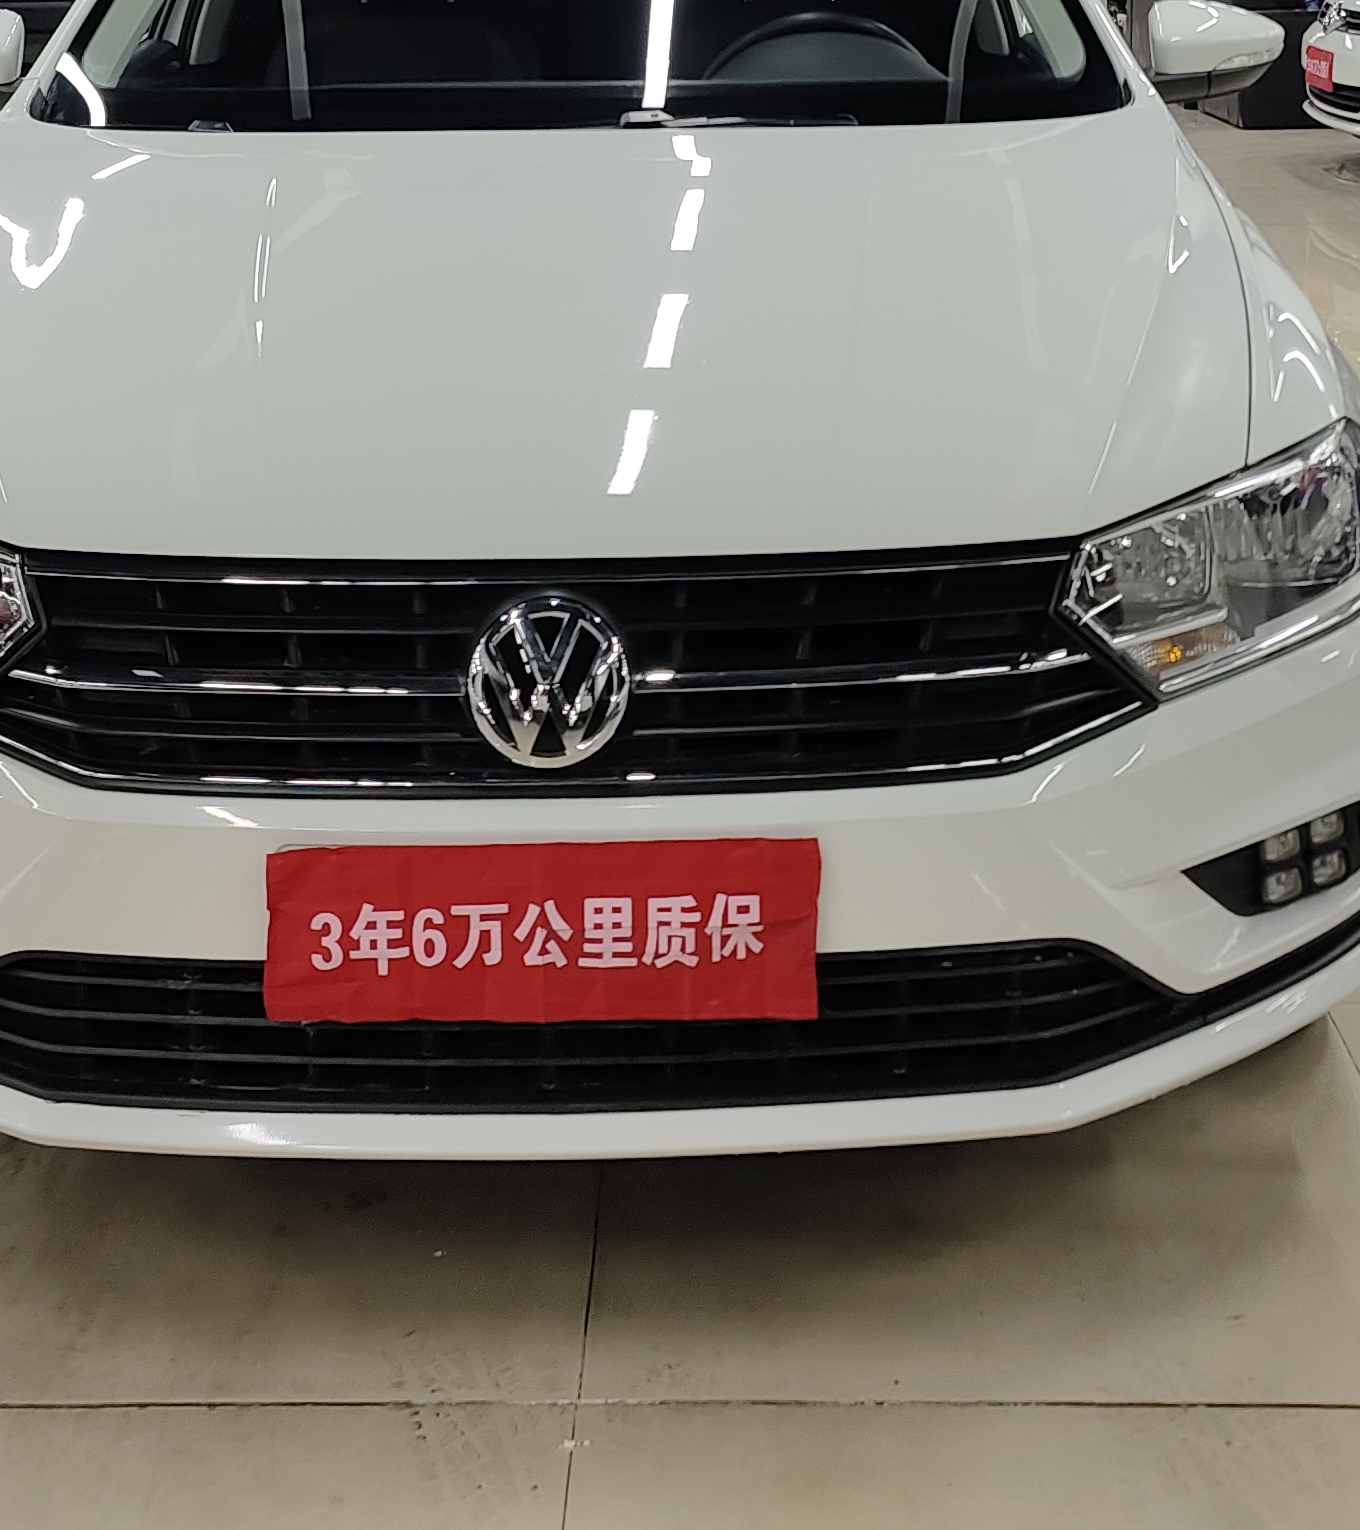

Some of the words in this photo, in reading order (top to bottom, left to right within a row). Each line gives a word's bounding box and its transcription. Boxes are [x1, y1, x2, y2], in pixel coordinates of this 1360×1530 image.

[308, 893, 765, 976] 3年6万公里质保
